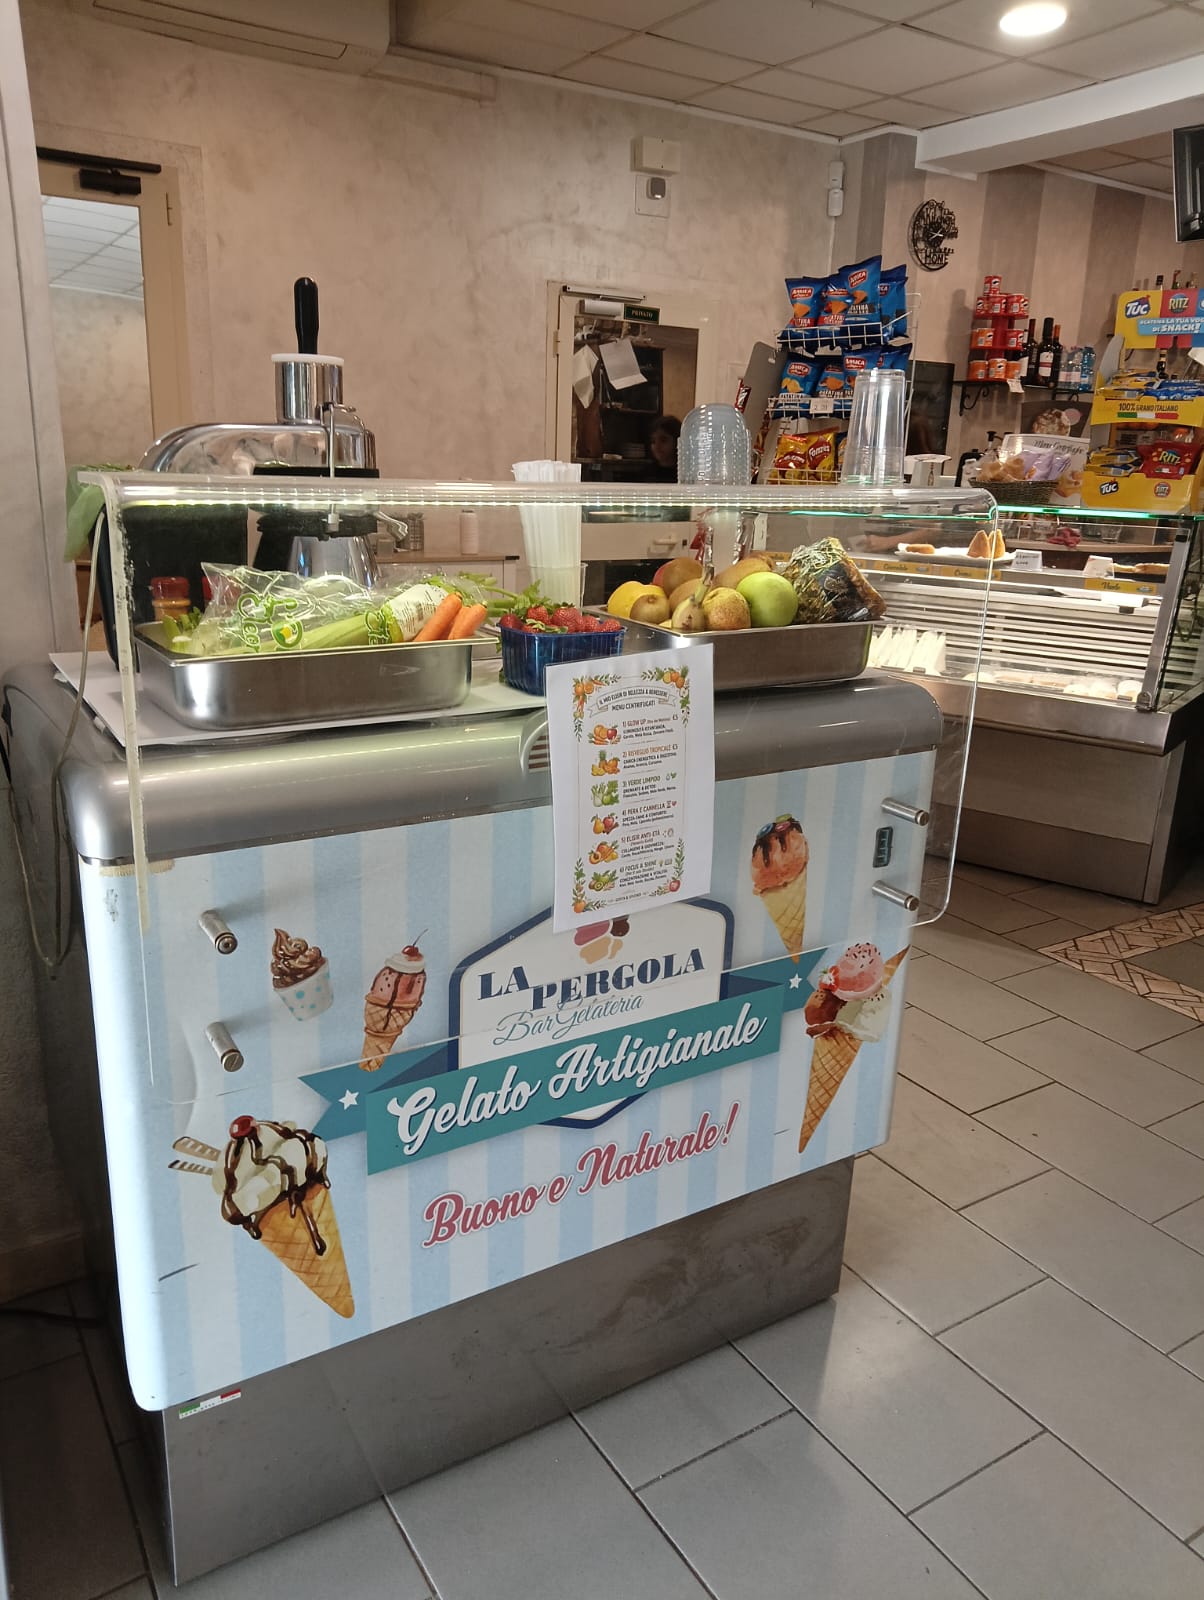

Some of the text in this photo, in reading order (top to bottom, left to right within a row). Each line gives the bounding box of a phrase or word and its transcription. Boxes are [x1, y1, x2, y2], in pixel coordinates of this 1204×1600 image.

[1126, 301, 1149, 316] TUC
[1169, 297, 1190, 311] RITZ
[631, 309, 654, 319] PRIVATO
[1161, 323, 1201, 334] SNACK!
[1119, 402, 1136, 411] 100%
[1154, 404, 1179, 412] ITALIANO
[1160, 450, 1181, 465] RITZ
[1101, 481, 1118, 494] TUC
[612, 699, 655, 712] MENU CENTRIFUGATI
[628, 778, 642, 787] VERDE
[627, 807, 639, 815] PERA
[643, 802, 666, 812] CANNELLA
[477, 948, 705, 1012] LA PERGOLA
[551, 994, 645, 1041] Gelateria
[387, 1002, 768, 1156] Gelato Artigianale
[423, 1101, 740, 1247] Buono e Naturale!
